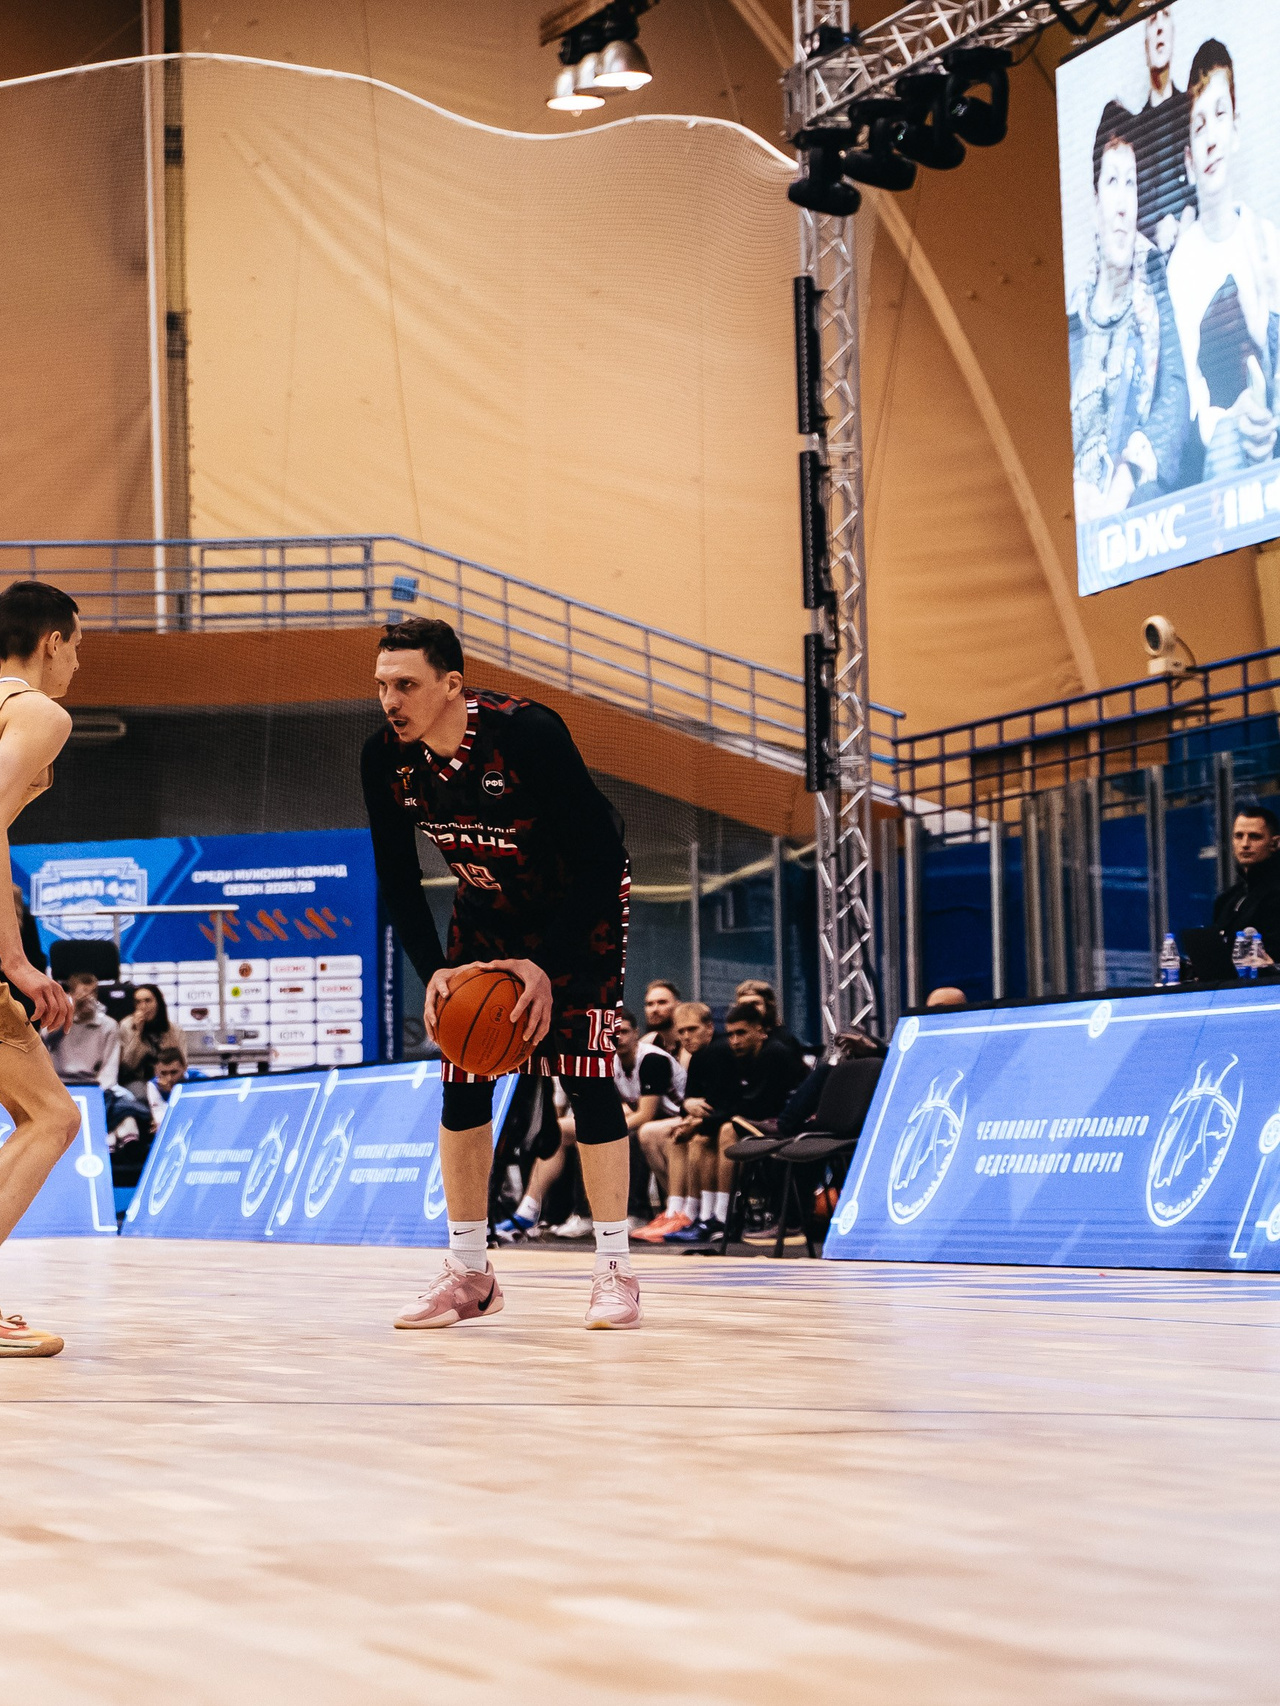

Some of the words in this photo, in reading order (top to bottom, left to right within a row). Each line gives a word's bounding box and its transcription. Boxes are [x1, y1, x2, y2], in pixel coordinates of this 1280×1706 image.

[451, 863, 502, 892] 12
[586, 1008, 616, 1052] 12
[976, 1118, 1048, 1140] ЧЕМПИОНАТ
[1048, 1115, 1150, 1142] ЦЕНТРАЛЬНОГО
[974, 1151, 1071, 1178] ФЕДЕРАЛЬНОГО
[1072, 1151, 1124, 1174] ОКРУГА
